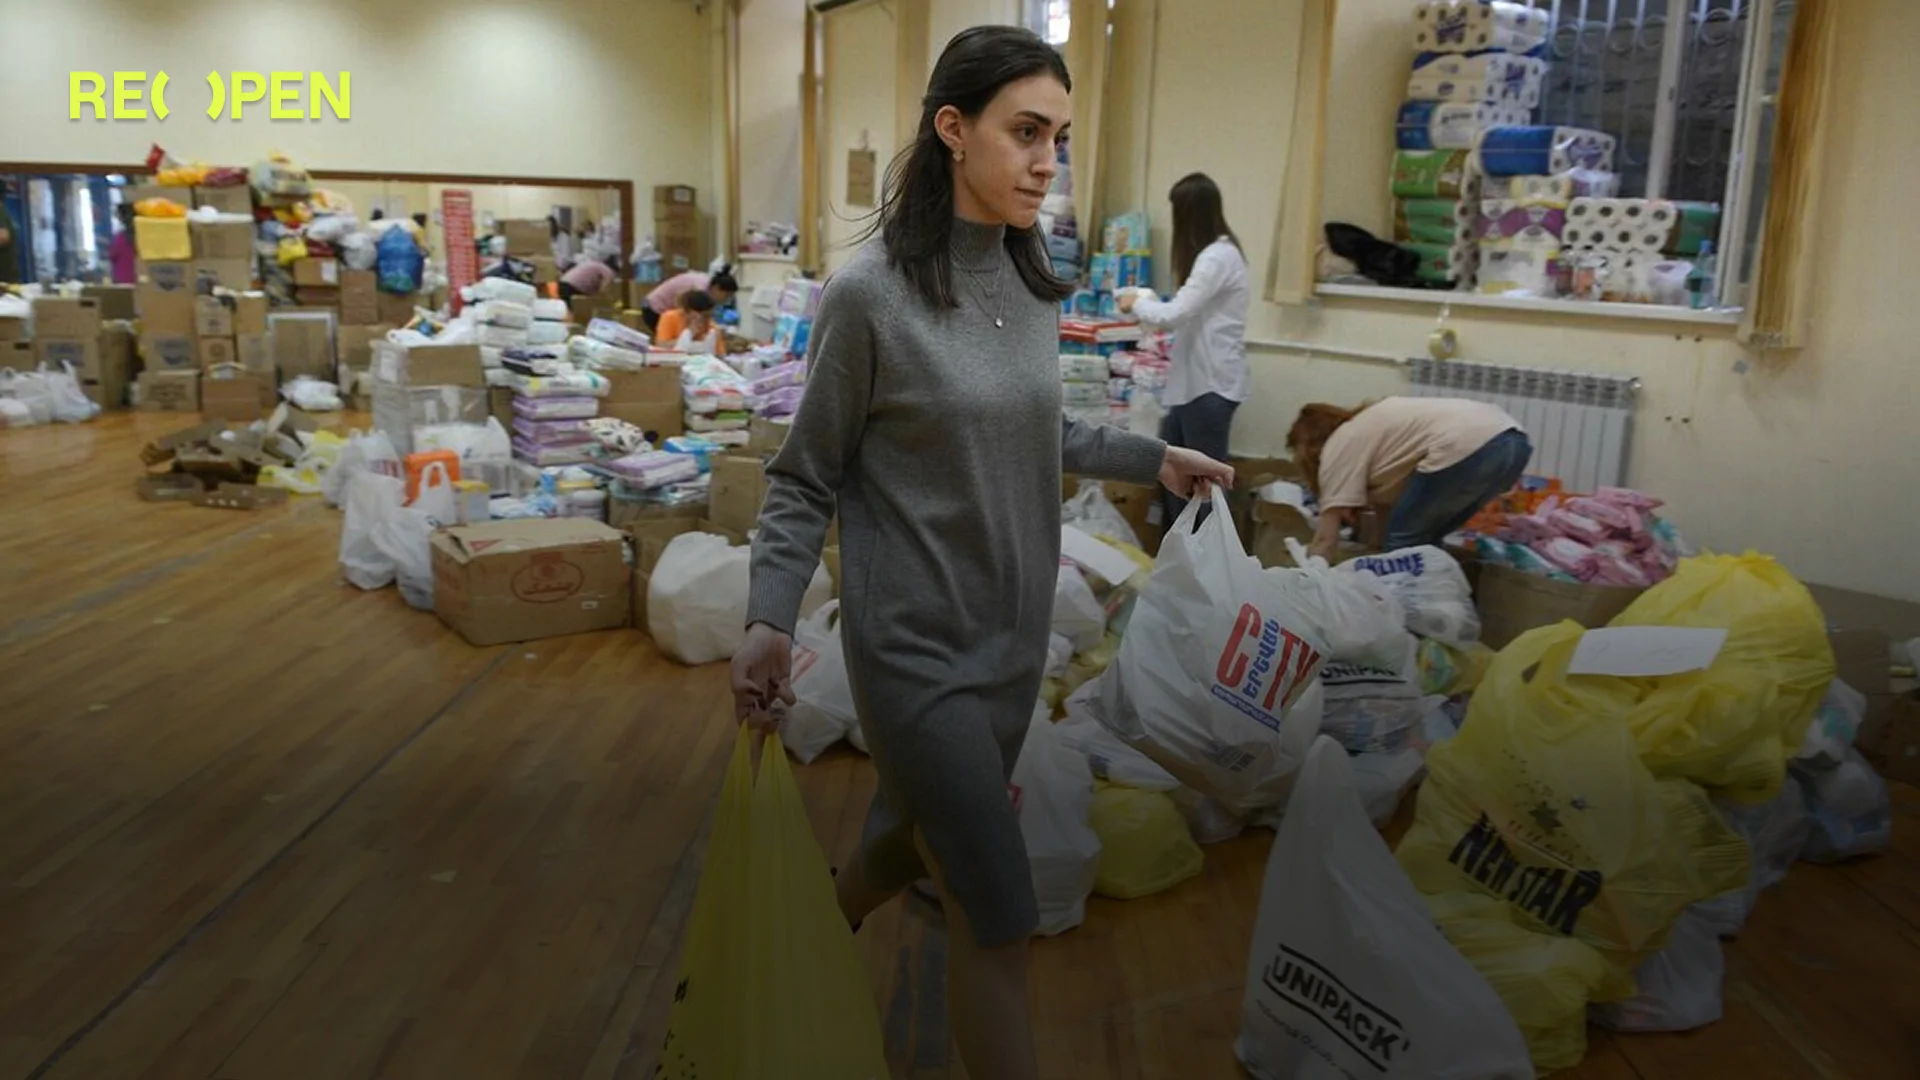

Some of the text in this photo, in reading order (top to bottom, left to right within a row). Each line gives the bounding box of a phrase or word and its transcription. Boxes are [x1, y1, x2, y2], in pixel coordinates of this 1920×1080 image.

[1448, 812, 1520, 893] NEW
[1508, 866, 1603, 935] STAR
[1272, 955, 1400, 1061] UNIPACK
